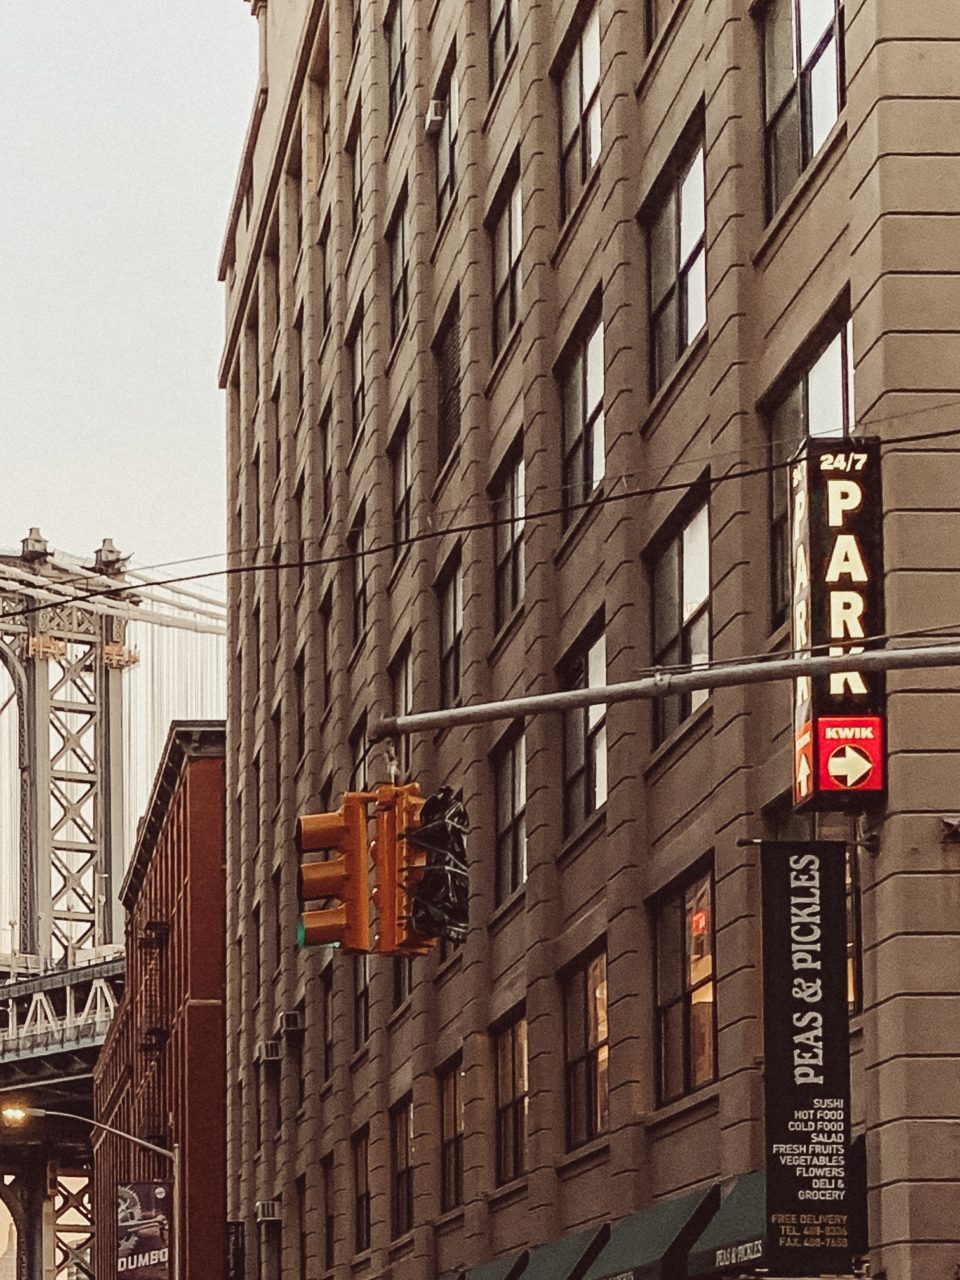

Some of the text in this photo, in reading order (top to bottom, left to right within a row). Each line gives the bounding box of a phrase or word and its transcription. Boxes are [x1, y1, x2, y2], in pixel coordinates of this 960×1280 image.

[820, 452, 868, 472] 24/7
[825, 727, 874, 739] KWIK
[789, 854, 824, 1085] PEAS & PICKLES
[813, 1099, 844, 1108] SUSHI
[794, 1110, 844, 1120] HOT FOOD
[788, 1121, 844, 1131] COLD FOOD
[811, 1133, 844, 1142] SALAD
[773, 1145, 845, 1154] FRESH FRUITS
[780, 1156, 845, 1165] VEGETABLES
[796, 1167, 845, 1177] FLOWERS
[812, 1179, 835, 1188] DELI
[798, 1190, 846, 1200] GROCERY
[771, 1214, 848, 1224] FREE DELIVERY
[117, 1248, 168, 1272] DUMBO
